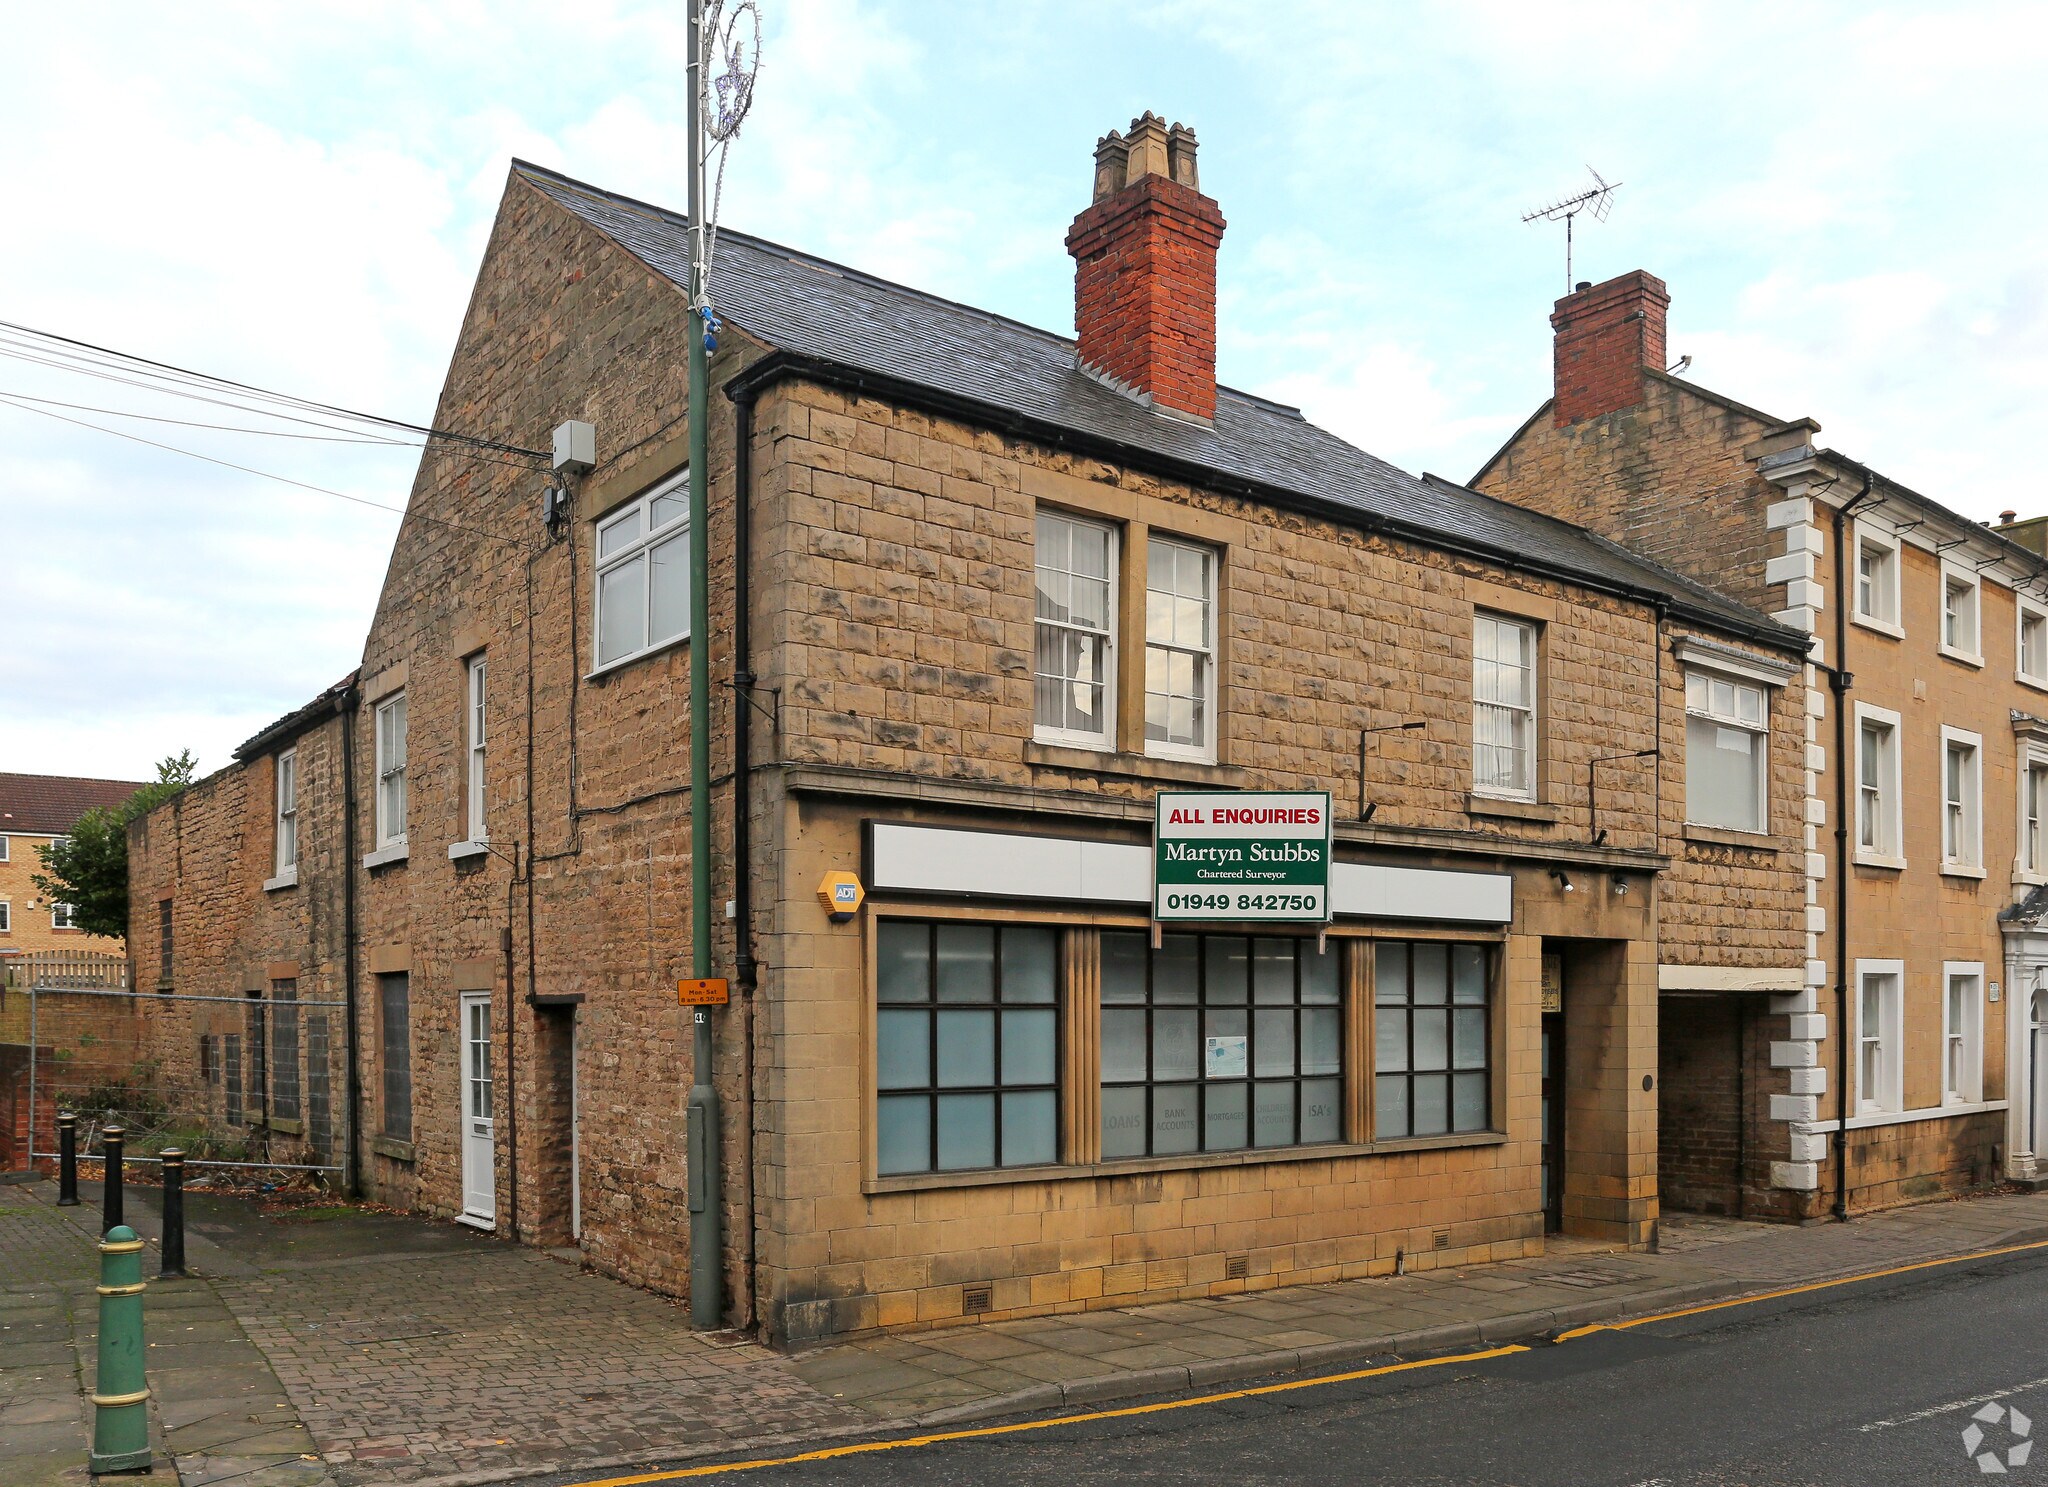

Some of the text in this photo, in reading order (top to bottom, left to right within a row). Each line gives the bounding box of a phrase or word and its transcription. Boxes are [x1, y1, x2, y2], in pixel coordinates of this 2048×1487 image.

[1169, 809, 1320, 824] ALL ENQUIRIES
[1164, 842, 1320, 866] Martyn Stubbs
[1197, 869, 1287, 881] Chartered Surveyor
[836, 887, 855, 898] ADT
[1167, 894, 1317, 911] 01949 842750
[1164, 1108, 1186, 1118] BANK
[1207, 1112, 1245, 1121] MORTGAGES
[1103, 1114, 1141, 1130] LOANS
[1156, 1120, 1195, 1131] ACCOUNTS
